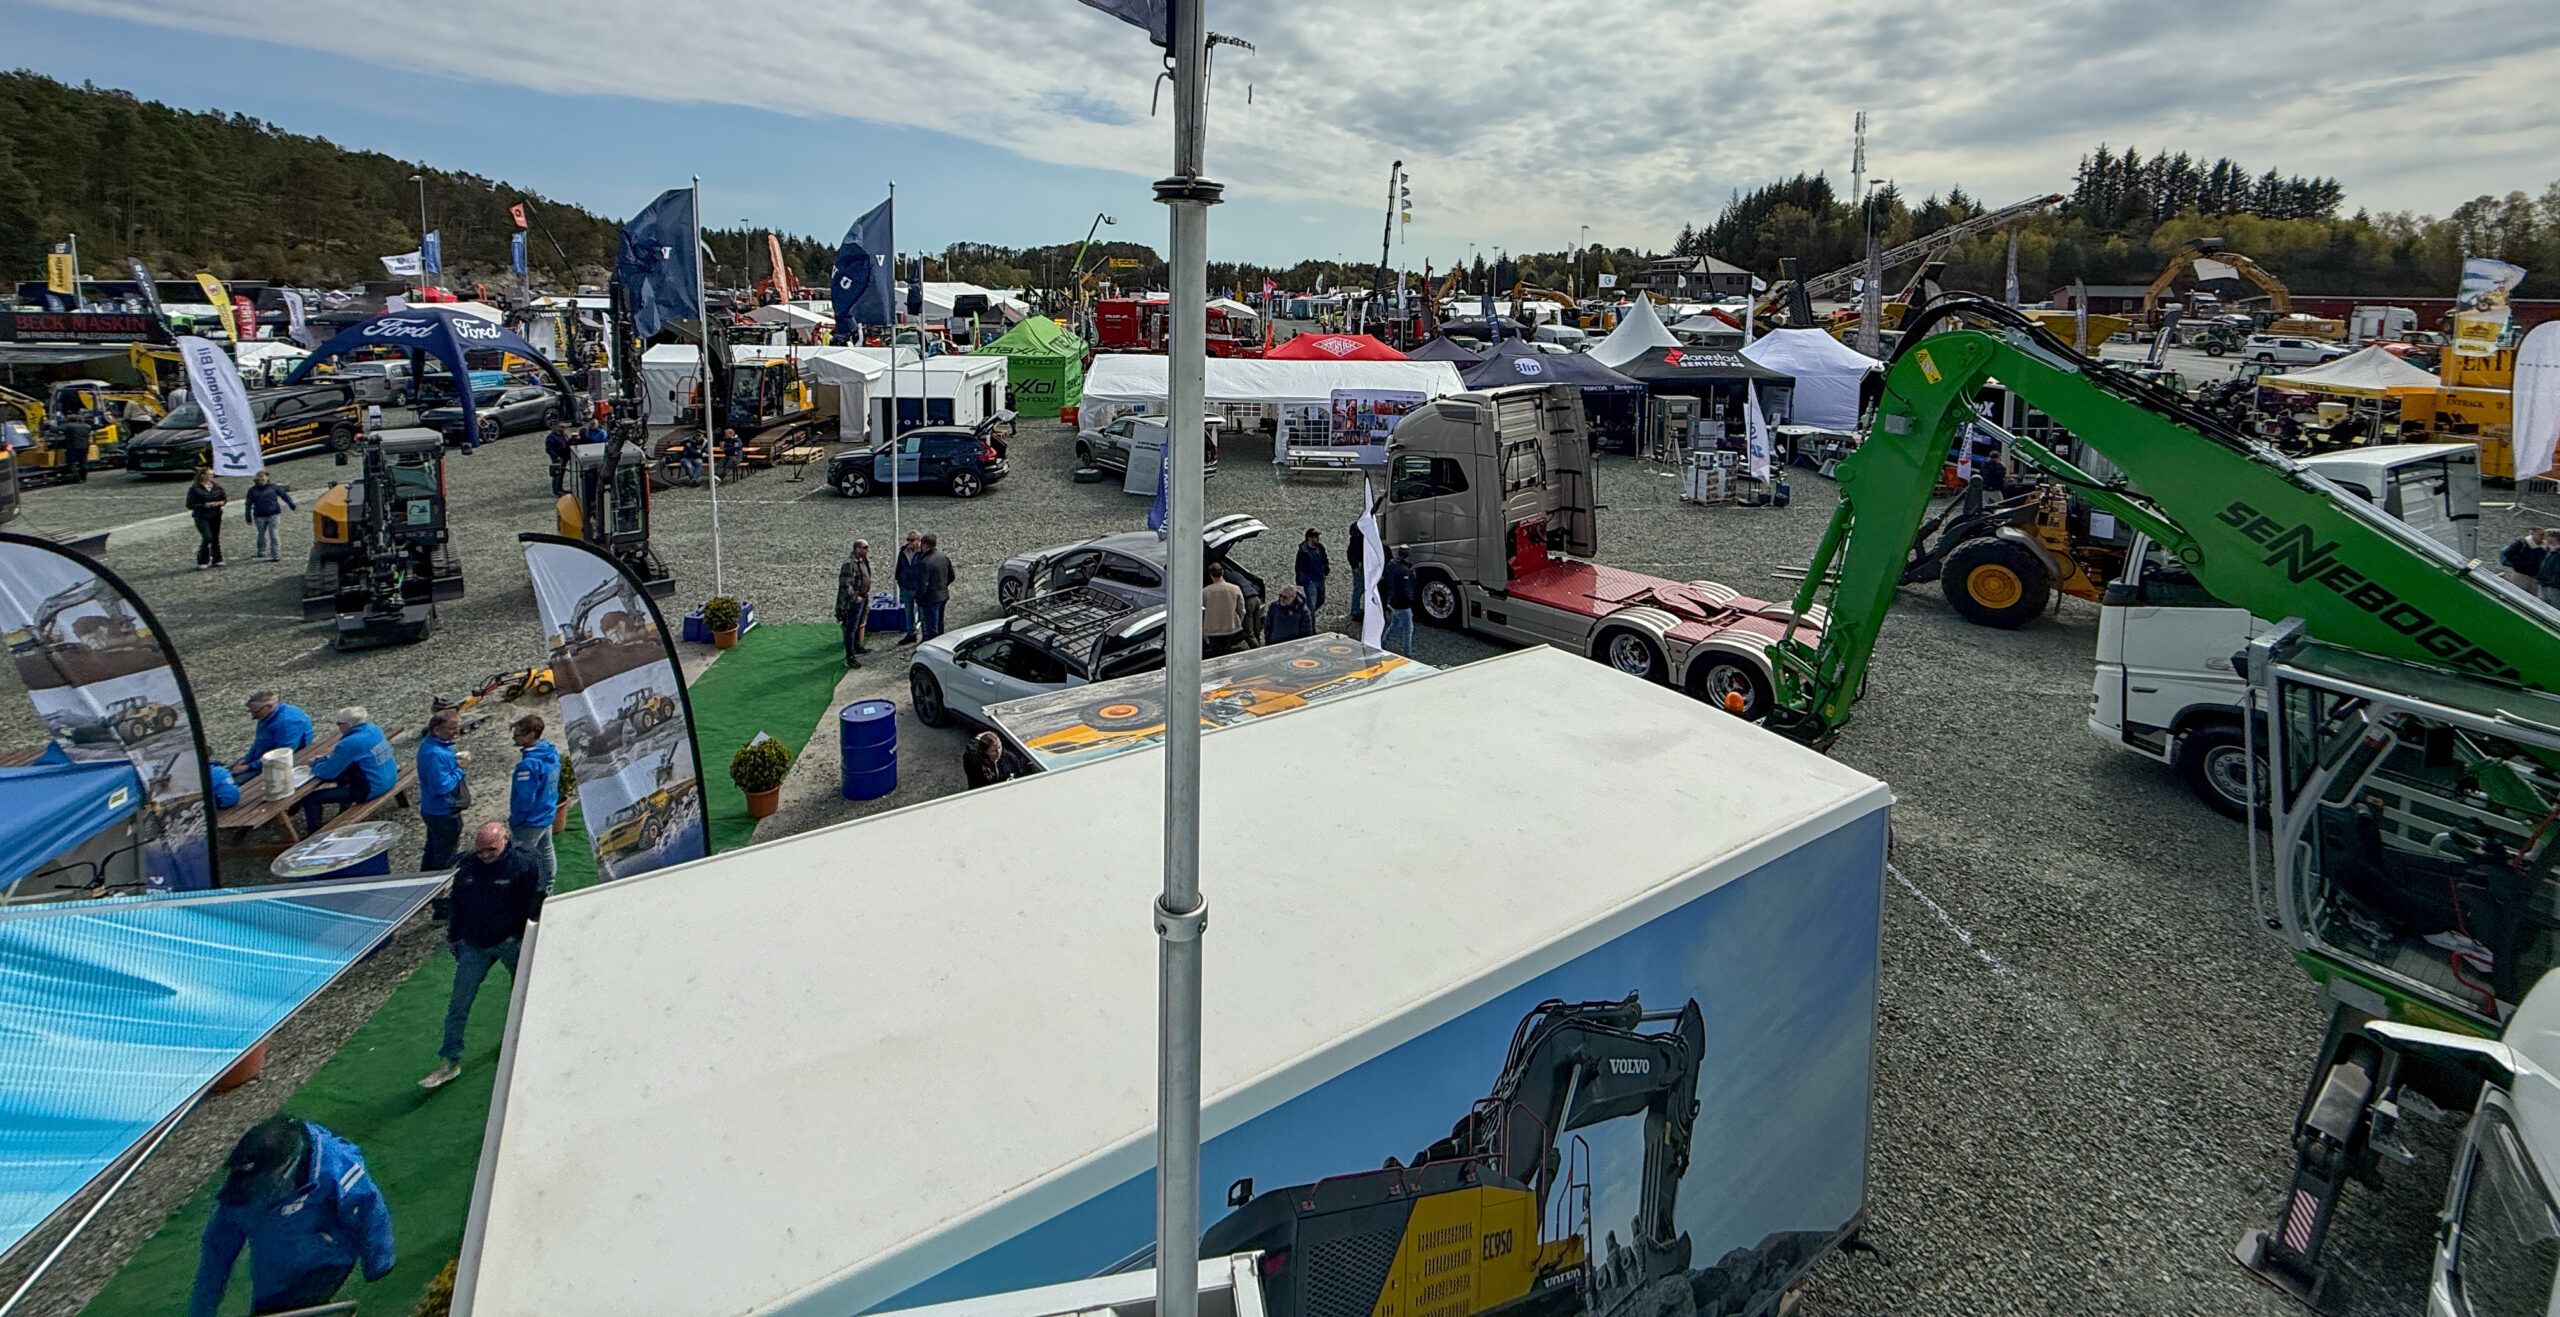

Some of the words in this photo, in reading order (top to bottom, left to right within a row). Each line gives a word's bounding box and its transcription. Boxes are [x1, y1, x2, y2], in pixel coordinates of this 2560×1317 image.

[14, 314, 66, 331] BECK
[72, 315, 146, 332] MASKIN
[362, 317, 440, 339] Ford
[452, 317, 502, 340] Ford
[1679, 353, 1740, 364] Aanestad
[2446, 398, 2485, 409] ENTRACK
[1609, 1057, 1651, 1075] VOLVO
[1482, 1227, 1513, 1262] EC950
